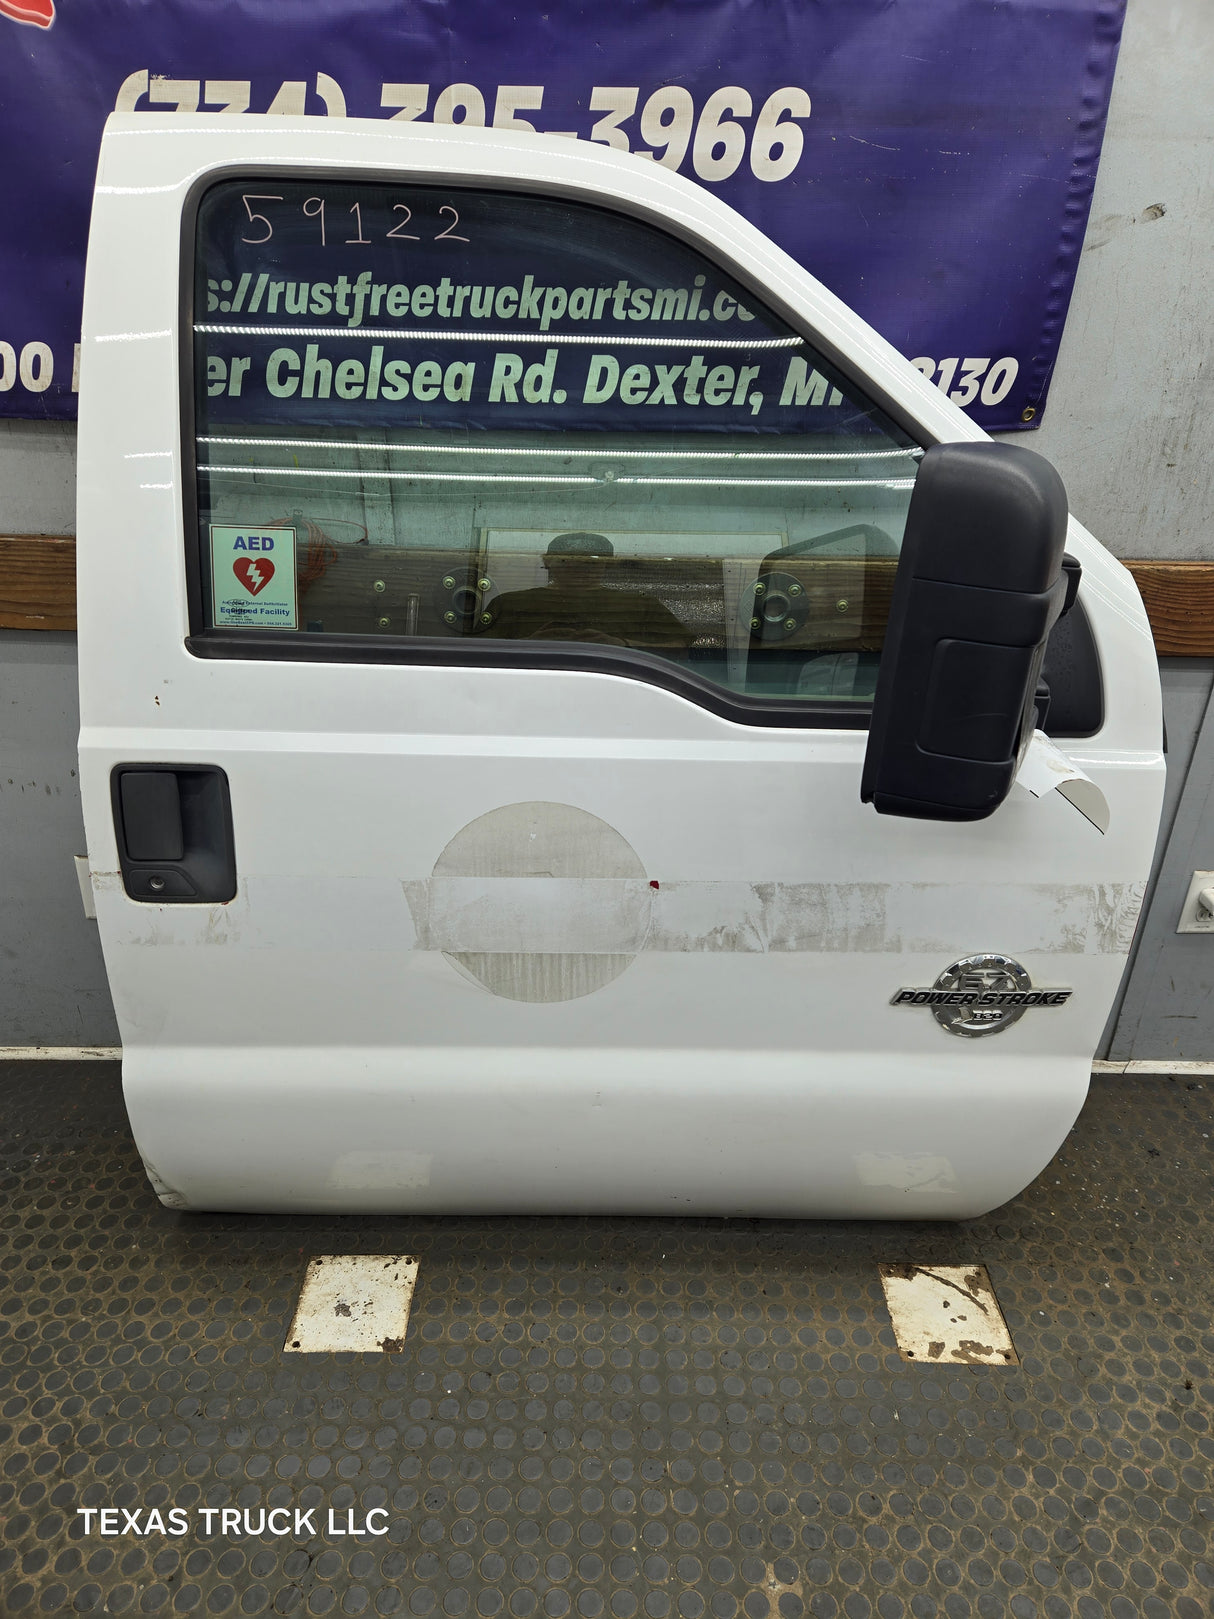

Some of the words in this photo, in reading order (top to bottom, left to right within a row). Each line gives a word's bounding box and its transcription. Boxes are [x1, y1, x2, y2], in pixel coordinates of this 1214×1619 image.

[241, 195, 470, 247] 59122
[265, 343, 476, 402] Chelsea
[487, 349, 568, 404] Rd.
[583, 354, 764, 416] Dexter,
[233, 535, 275, 552] AED
[260, 607, 290, 617] Facility
[892, 989, 978, 1006] POWER
[978, 990, 1073, 1006] STROKE
